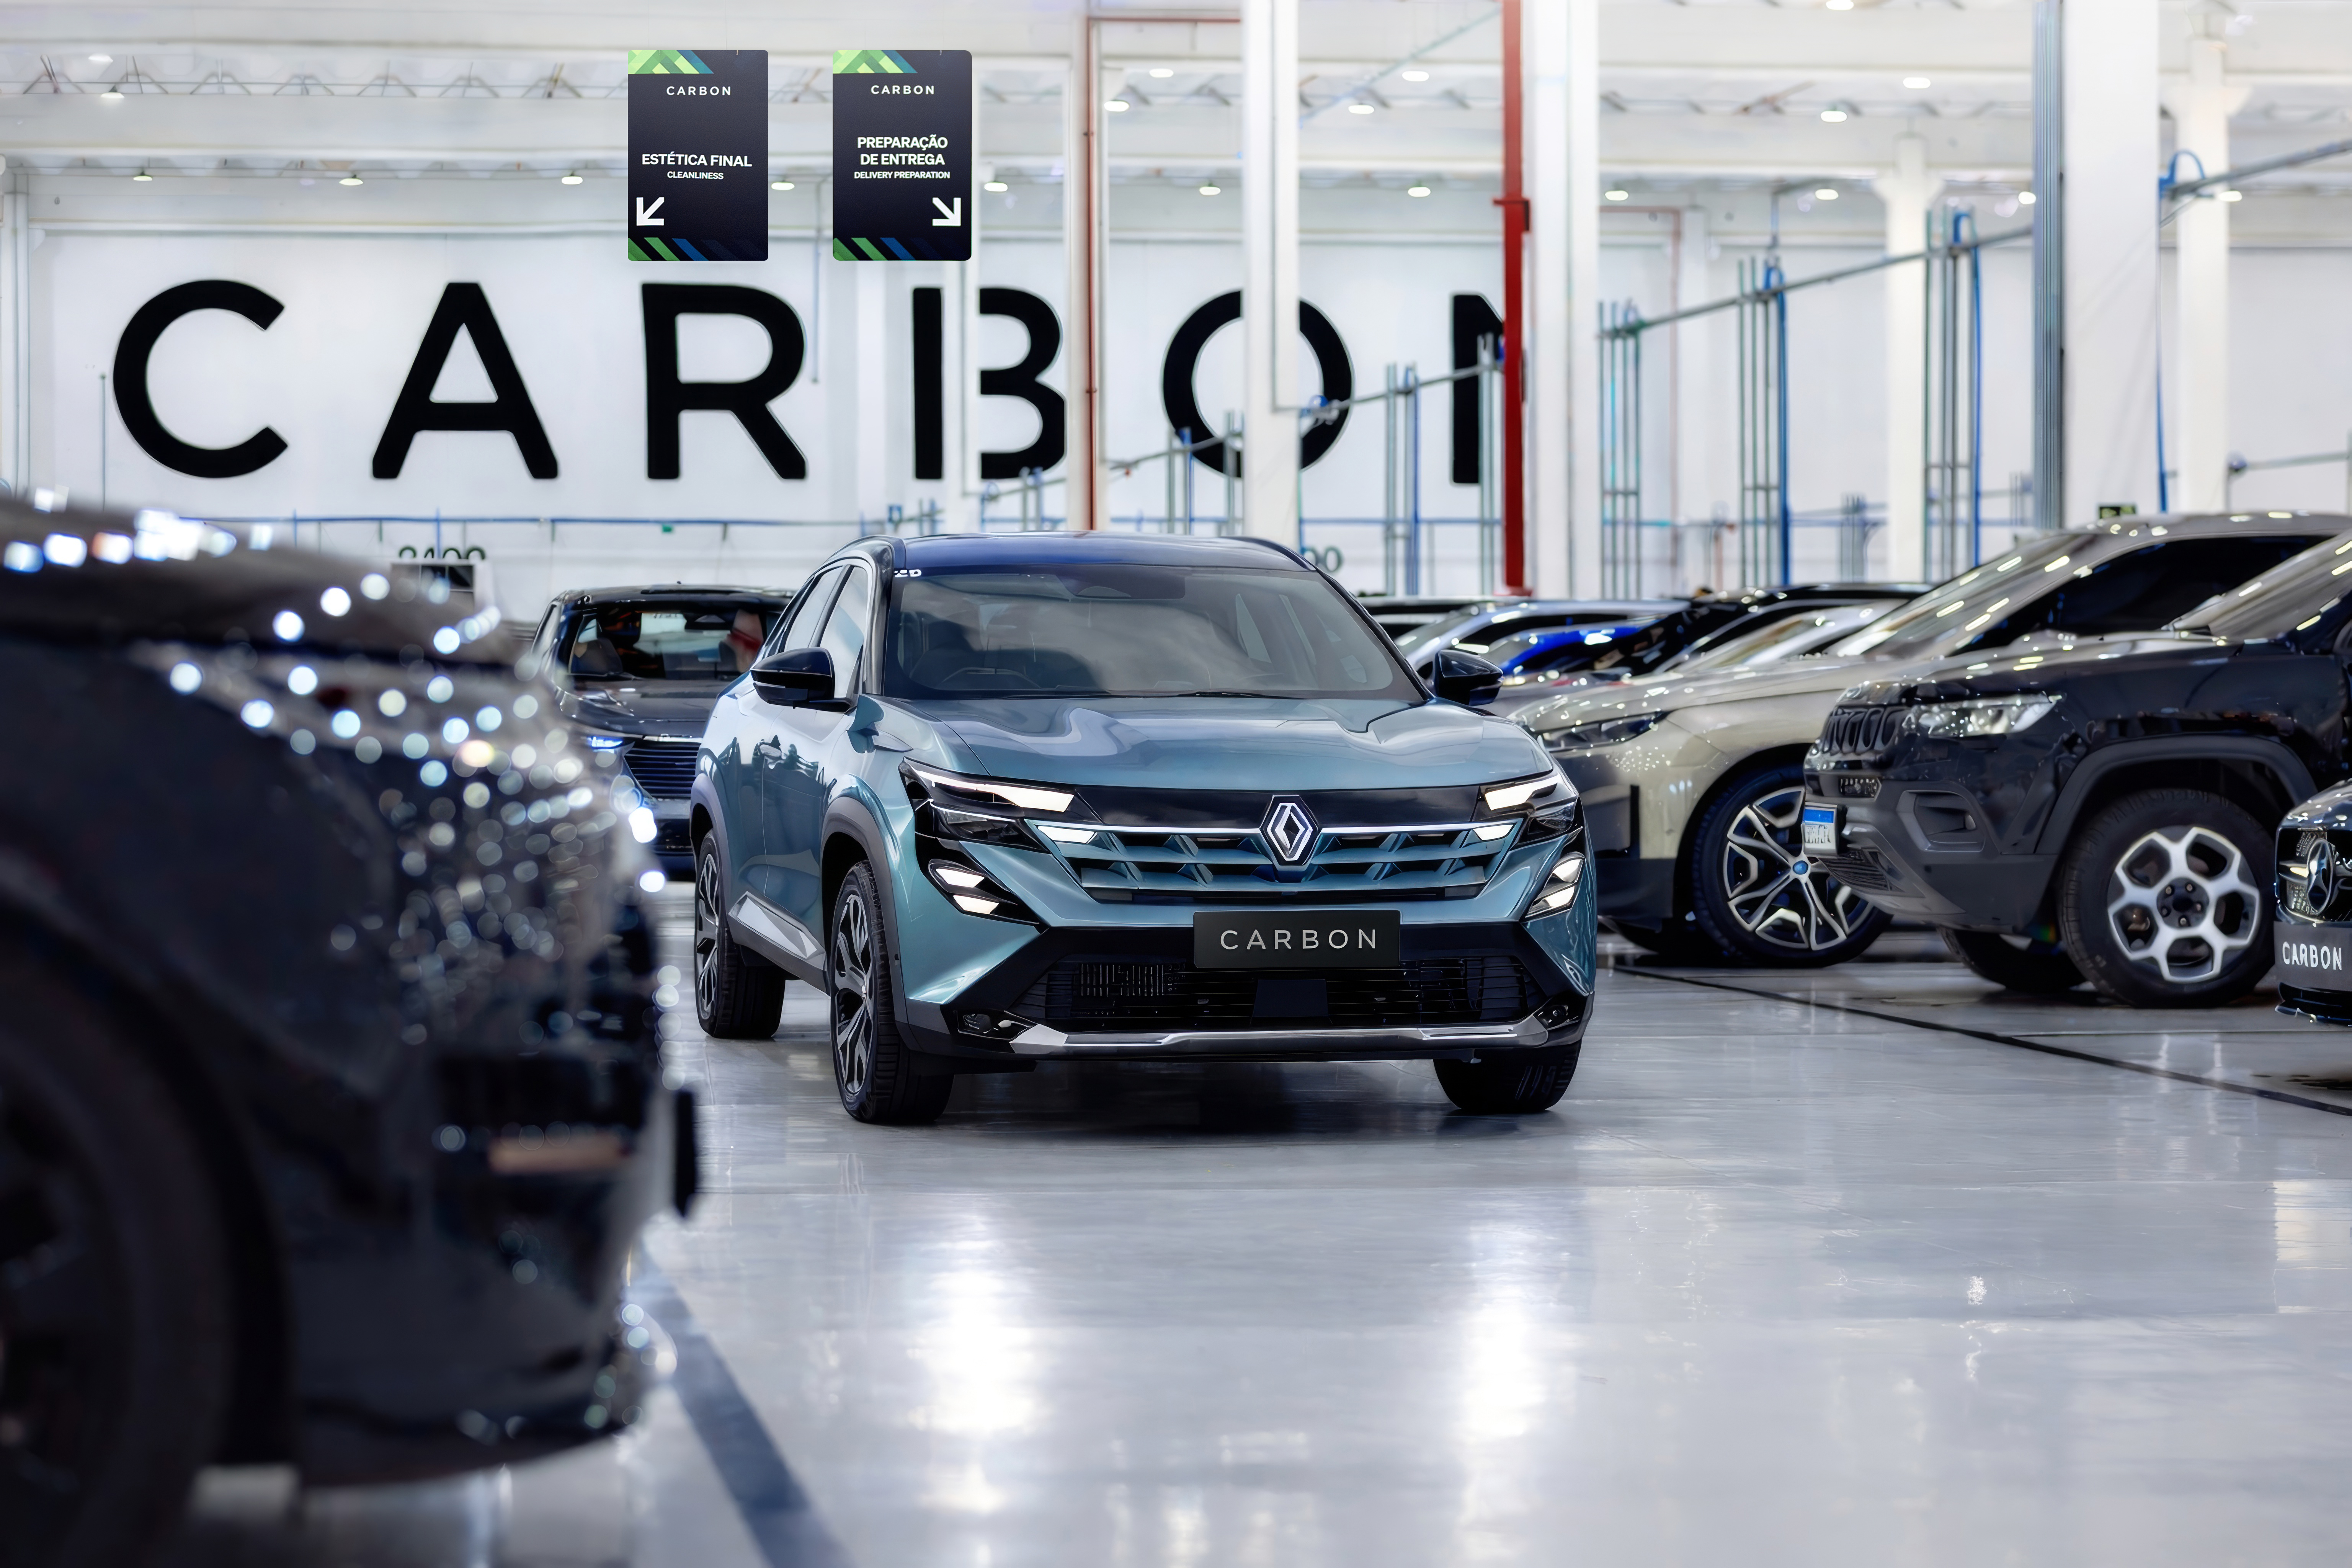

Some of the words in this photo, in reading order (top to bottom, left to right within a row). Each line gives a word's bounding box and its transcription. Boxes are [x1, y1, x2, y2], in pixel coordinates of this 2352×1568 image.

[666, 86, 731, 96] CARBON
[871, 85, 934, 95] CARBON
[858, 134, 948, 150] PREPARAÇÃO
[642, 152, 708, 166] ESTÉTICA
[710, 155, 752, 167] FINAL
[861, 154, 879, 165] DE
[881, 154, 945, 165] ENTREGA
[667, 171, 724, 180] CLEANLINESS
[1220, 929, 1375, 950] CARBON
[2282, 941, 2342, 970] CARBON
